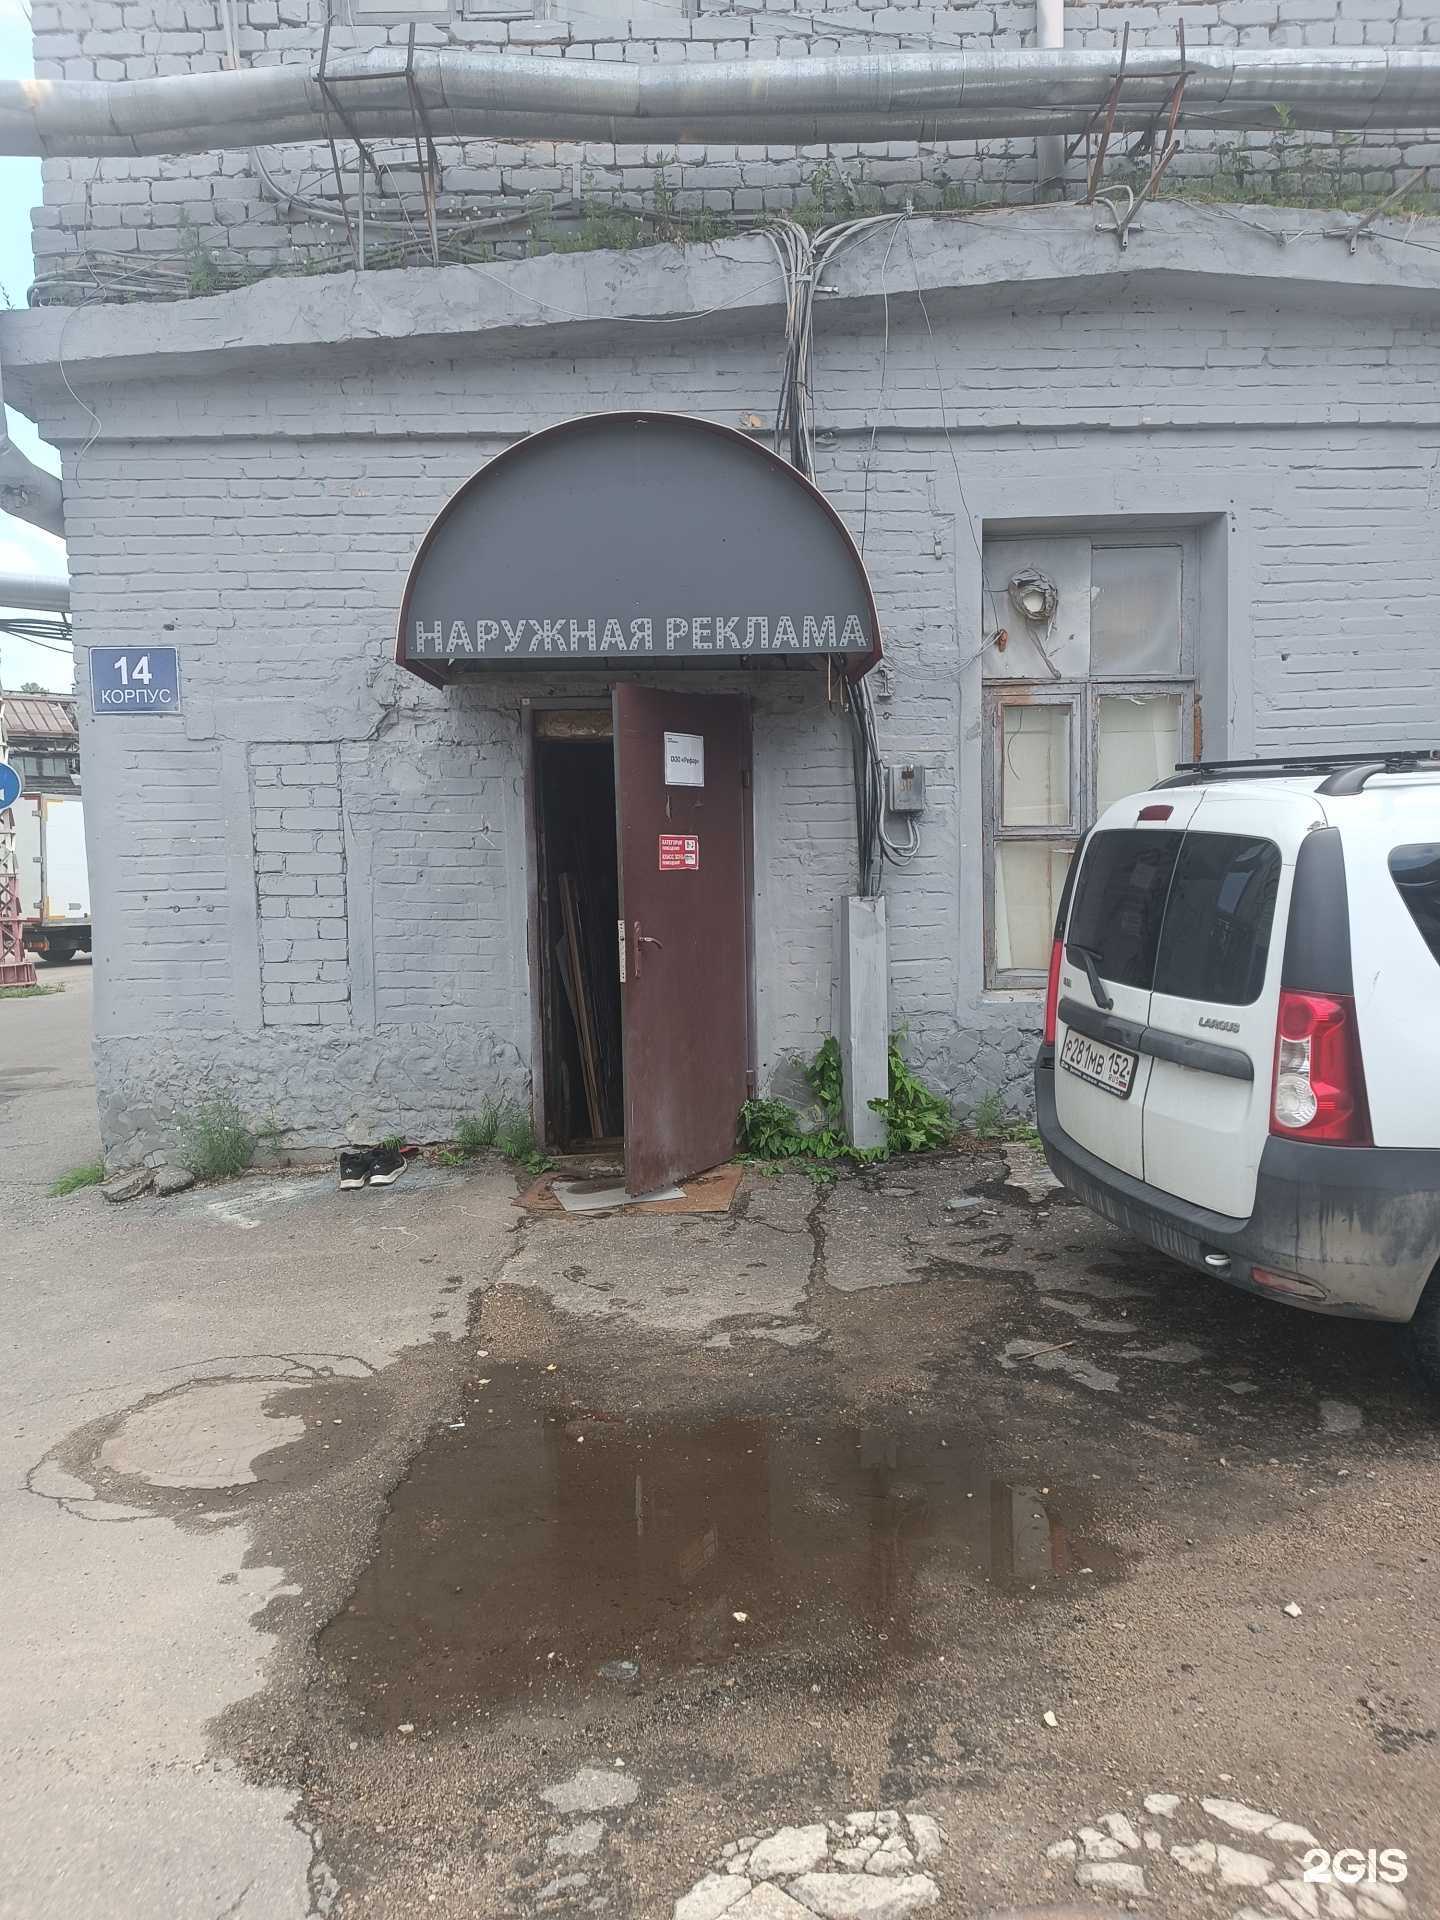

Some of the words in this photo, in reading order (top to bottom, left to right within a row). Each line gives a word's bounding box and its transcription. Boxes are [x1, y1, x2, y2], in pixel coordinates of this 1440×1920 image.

[415, 618, 652, 653] НАРУЖНАЯ
[666, 615, 867, 651] РЕКЛАМА
[114, 656, 152, 685] 14
[101, 688, 172, 704] КОРПУС
[1198, 1016, 1241, 1033] LARGUS
[1108, 1052, 1129, 1078] 152
